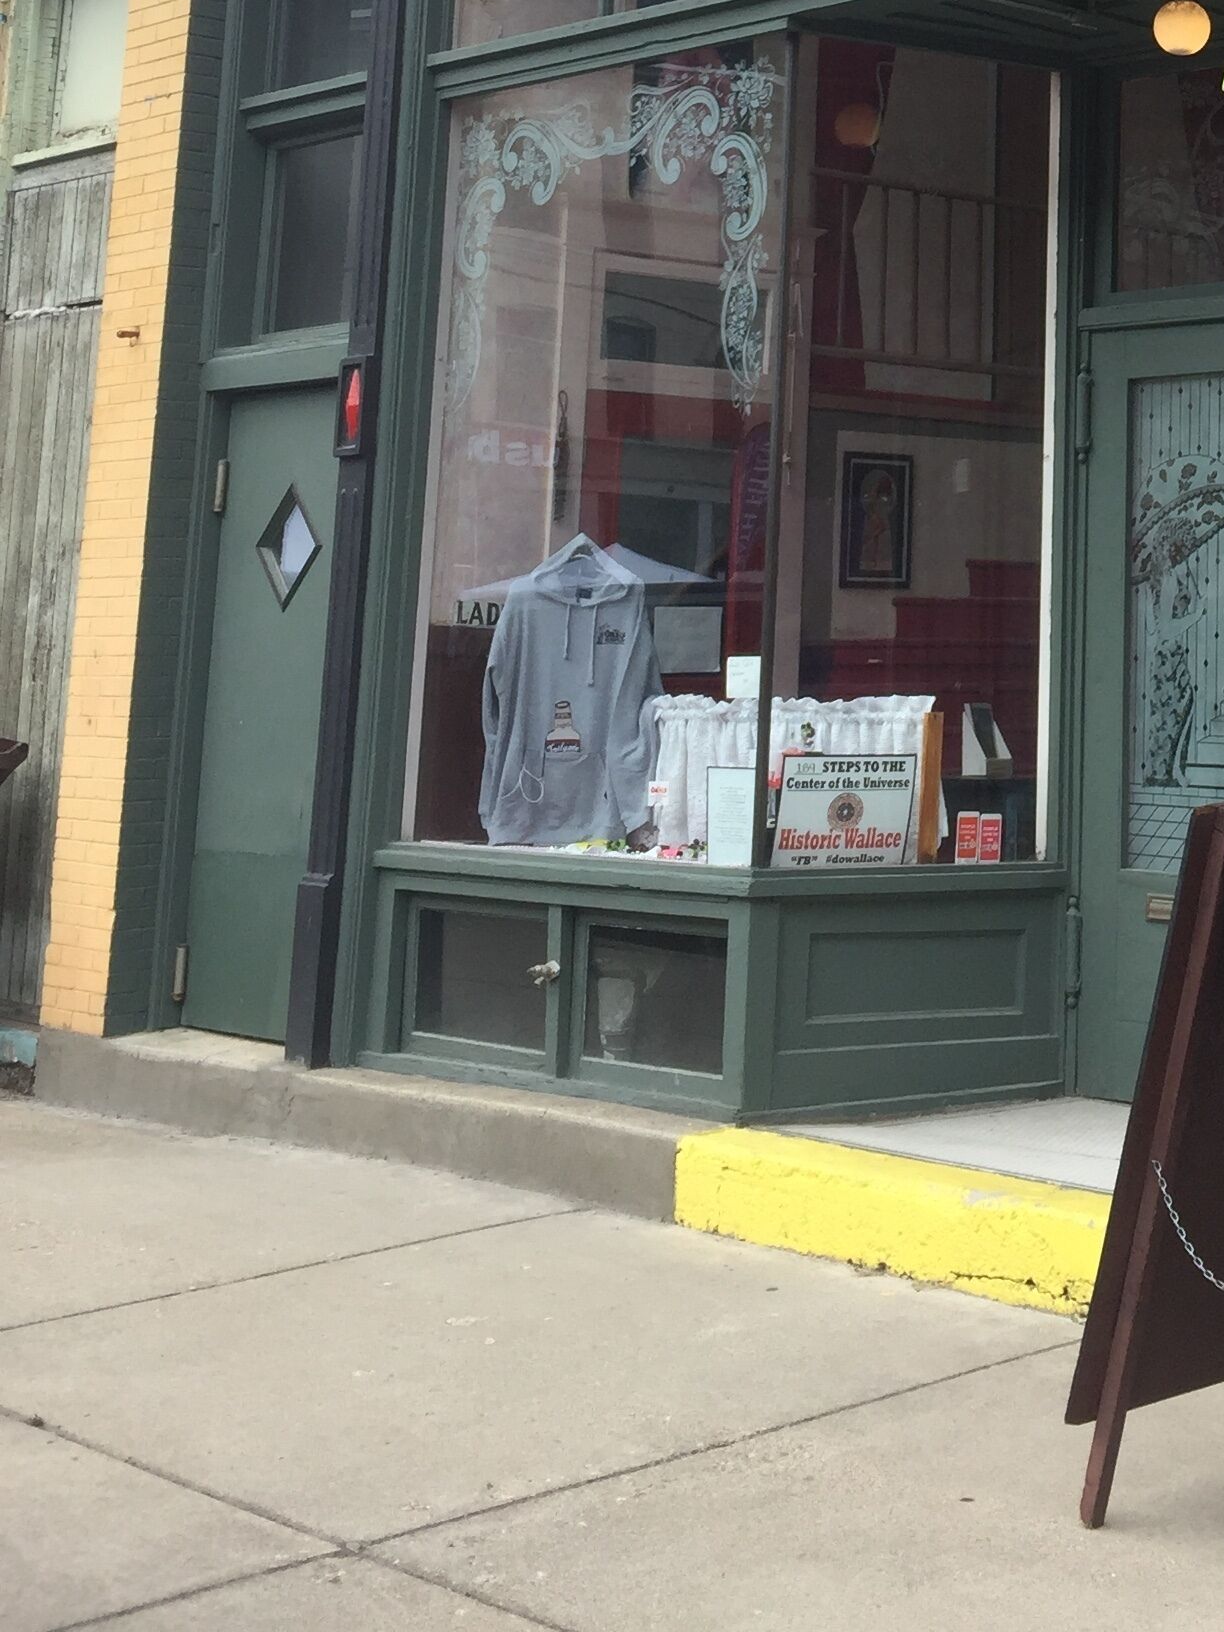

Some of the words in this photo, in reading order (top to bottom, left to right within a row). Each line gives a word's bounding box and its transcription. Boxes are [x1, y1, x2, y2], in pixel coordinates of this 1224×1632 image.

[455, 599, 501, 625] LAD
[822, 760, 861, 773] STEPS
[863, 760, 880, 773] TO
[882, 759, 906, 773] THE
[786, 777, 826, 789] Center
[828, 777, 841, 789] of
[842, 777, 861, 789] the
[862, 776, 910, 789] Universe
[778, 828, 842, 850] Historic
[844, 826, 902, 849] Wallace
